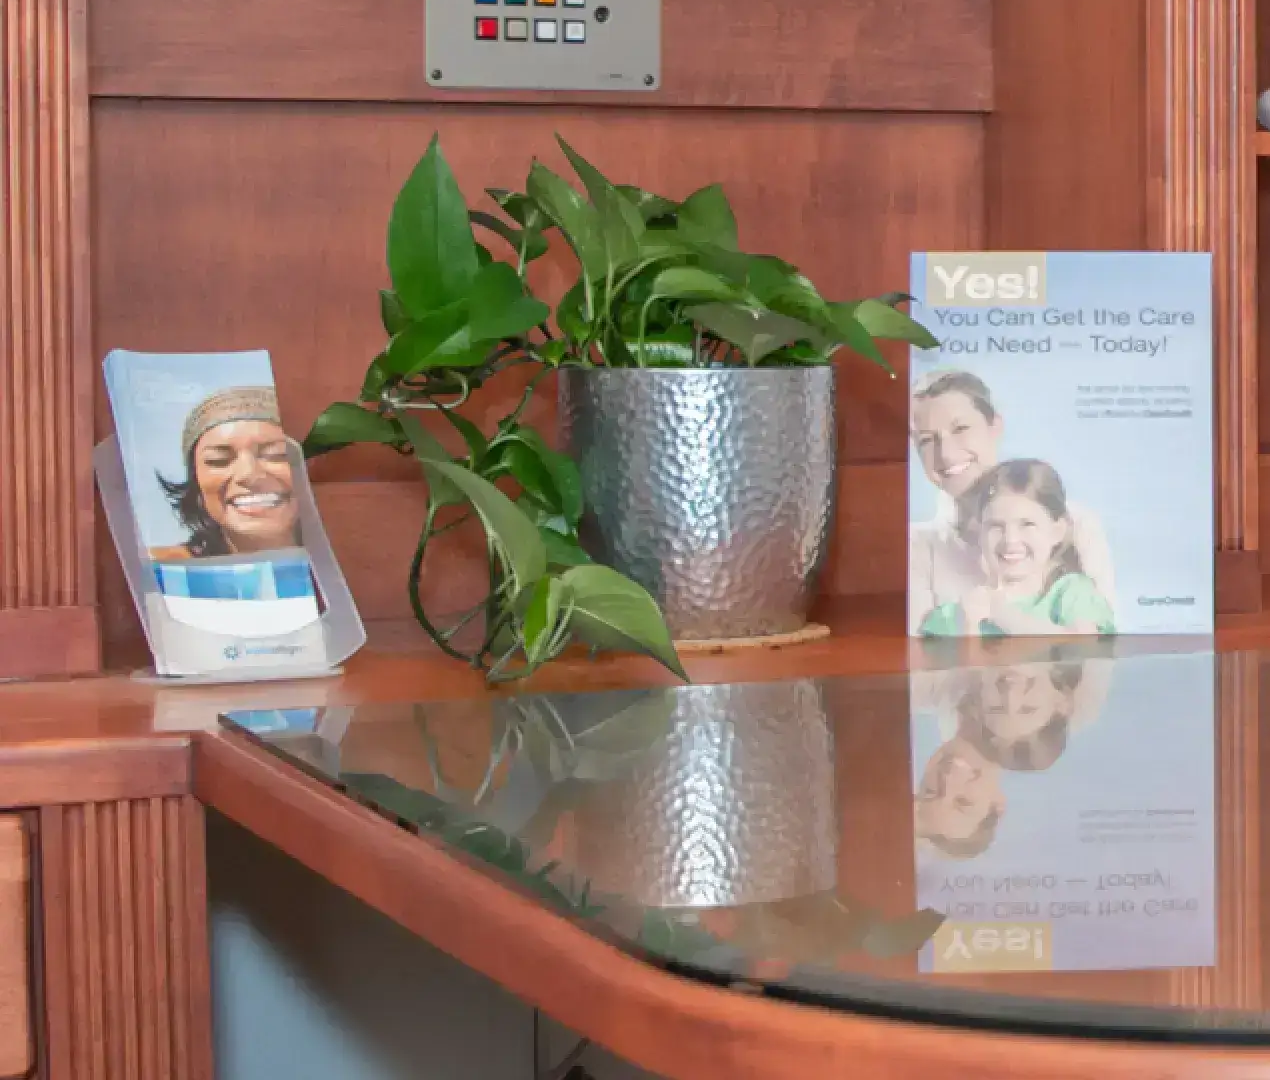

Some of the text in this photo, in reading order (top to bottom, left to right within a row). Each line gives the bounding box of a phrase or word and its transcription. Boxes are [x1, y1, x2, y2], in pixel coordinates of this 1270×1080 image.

[934, 264, 1039, 300] Yes!
[934, 307, 1196, 328] You Can Get the Care
[936, 335, 979, 355] You
[987, 335, 1053, 355] Need
[1090, 334, 1169, 358] Today!
